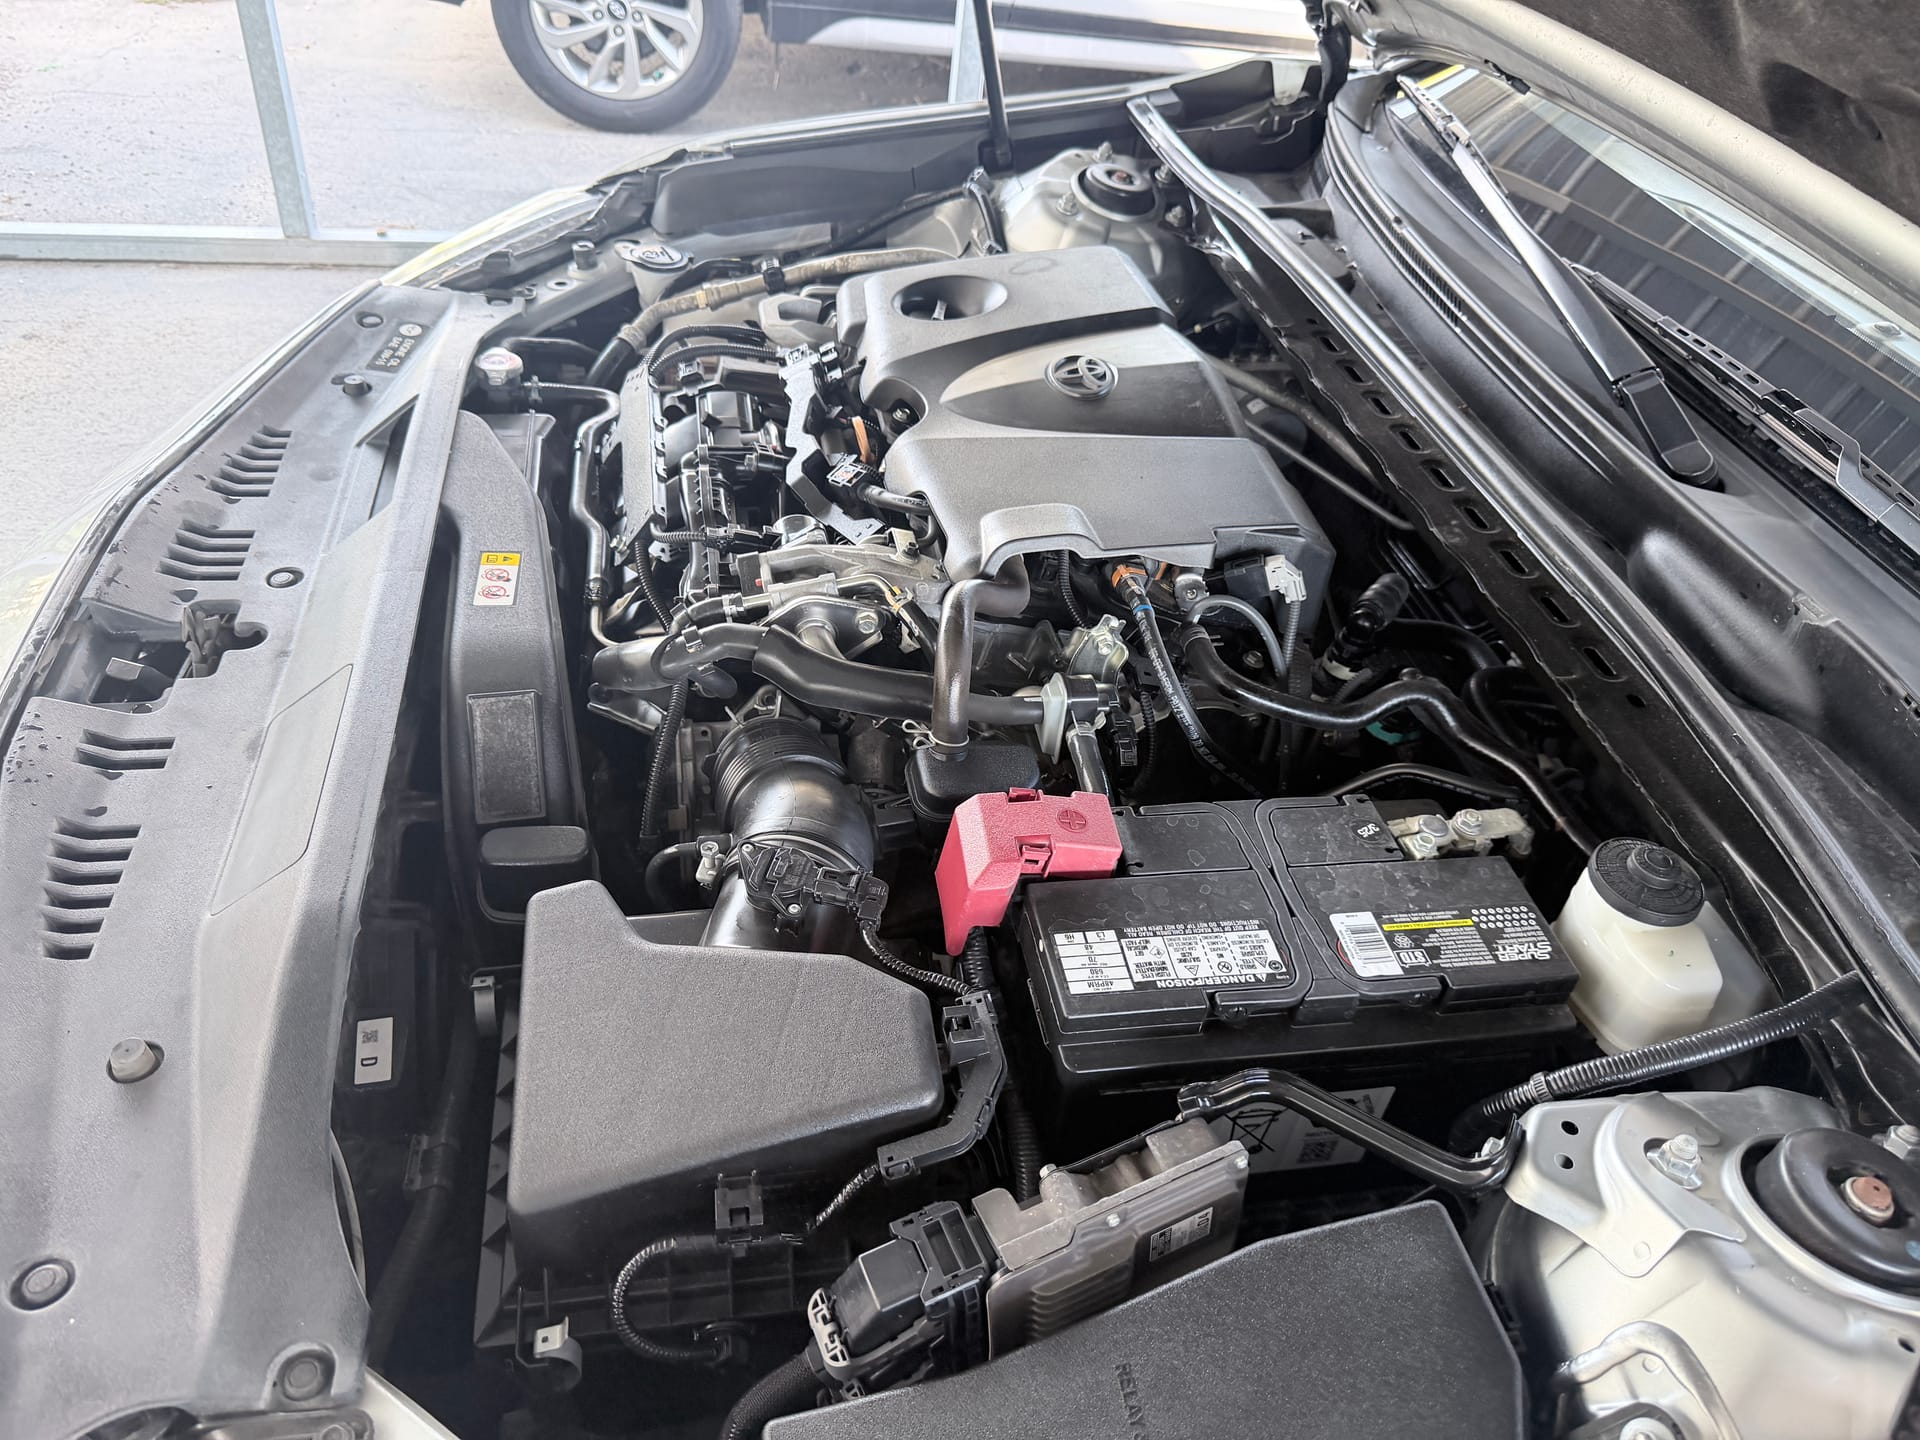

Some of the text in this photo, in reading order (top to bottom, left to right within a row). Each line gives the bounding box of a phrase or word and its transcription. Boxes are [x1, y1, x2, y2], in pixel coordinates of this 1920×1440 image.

[1357, 823, 1380, 838] 3/25
[1491, 941, 1553, 955] START
[1496, 950, 1551, 962] SUPER
[1155, 974, 1255, 988] DANGER/POISON
[360, 1056, 378, 1067] D
[1114, 1362, 1146, 1427] RELAY
